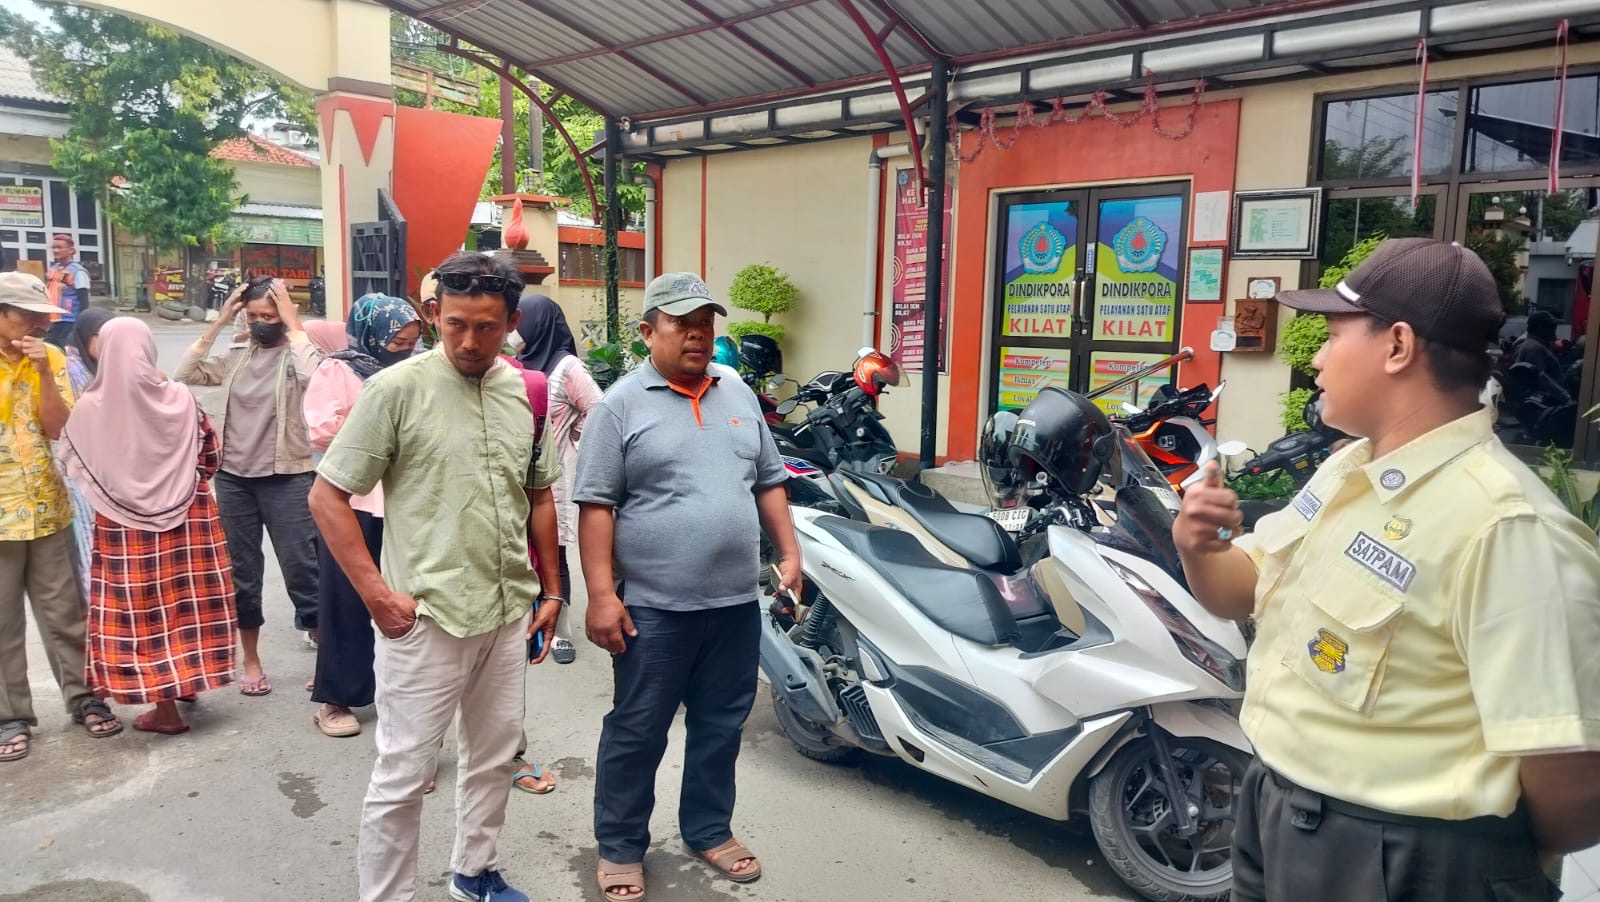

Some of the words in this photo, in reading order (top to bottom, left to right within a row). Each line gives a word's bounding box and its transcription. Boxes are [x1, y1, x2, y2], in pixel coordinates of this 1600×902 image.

[1008, 283, 1070, 297] DINDIKPORA
[1102, 282, 1172, 297] DINDIKPORA
[1007, 304, 1038, 314] PELAYANAN
[1040, 304, 1055, 314] SATU
[1056, 304, 1072, 314] ATAP
[1100, 304, 1135, 315] PELAYANAN
[1136, 304, 1153, 315] SATU
[1154, 304, 1172, 315] ATAP
[1010, 318, 1066, 333] KILAT
[1103, 320, 1166, 336] KILAT
[1014, 376, 1036, 385] Ikhlas
[1012, 510, 1027, 520] CIG
[1352, 538, 1410, 583] SATPAM
